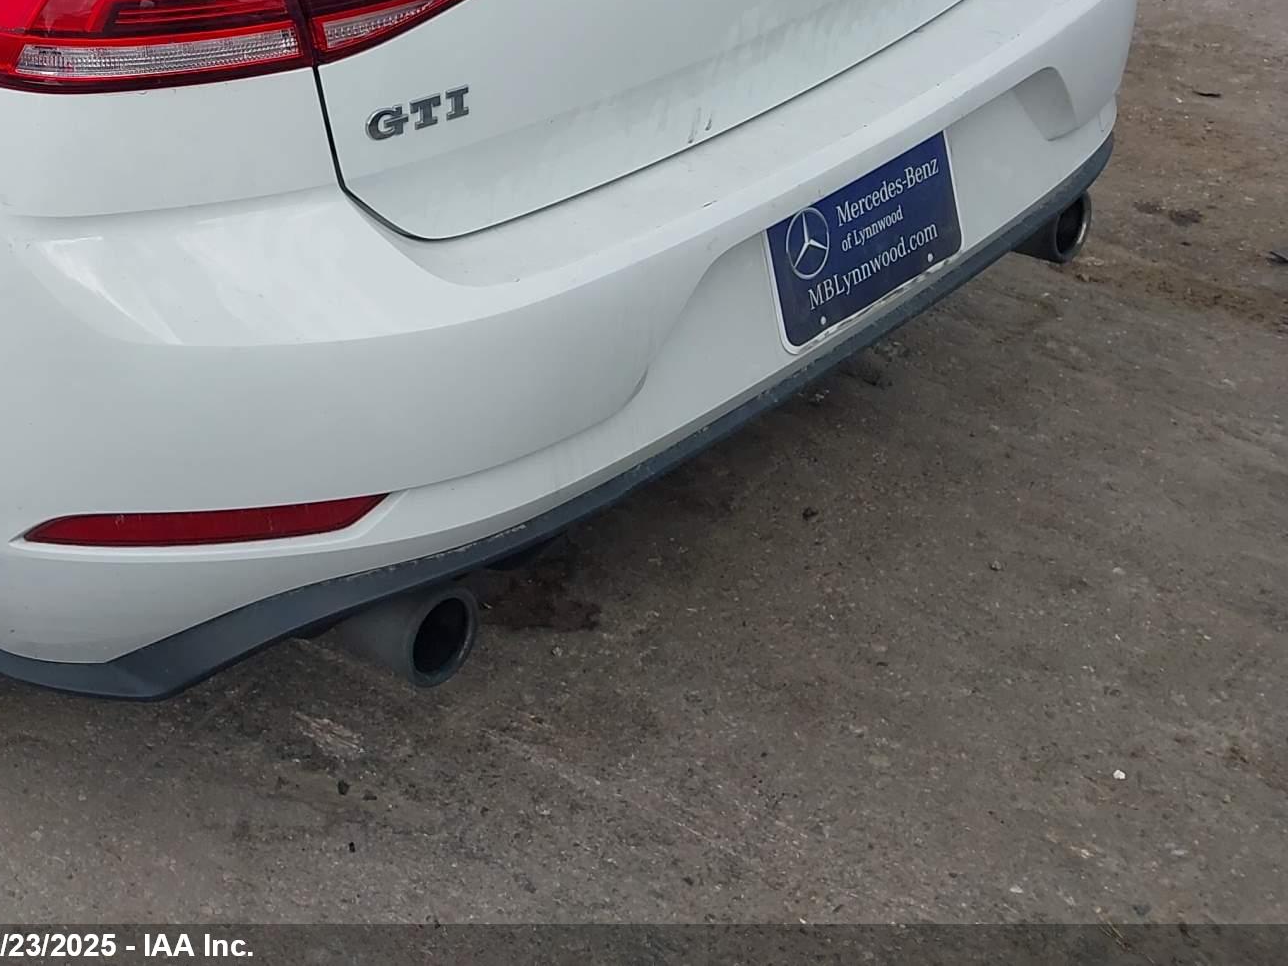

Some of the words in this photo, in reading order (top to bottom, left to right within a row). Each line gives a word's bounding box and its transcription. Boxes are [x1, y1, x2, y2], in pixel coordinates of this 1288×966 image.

[365, 84, 470, 141] GTI
[835, 157, 940, 227] Mercedes-Benz
[841, 233, 853, 252] of
[852, 204, 905, 247] Lynnwood
[807, 222, 939, 311] MBLynnwood.com
